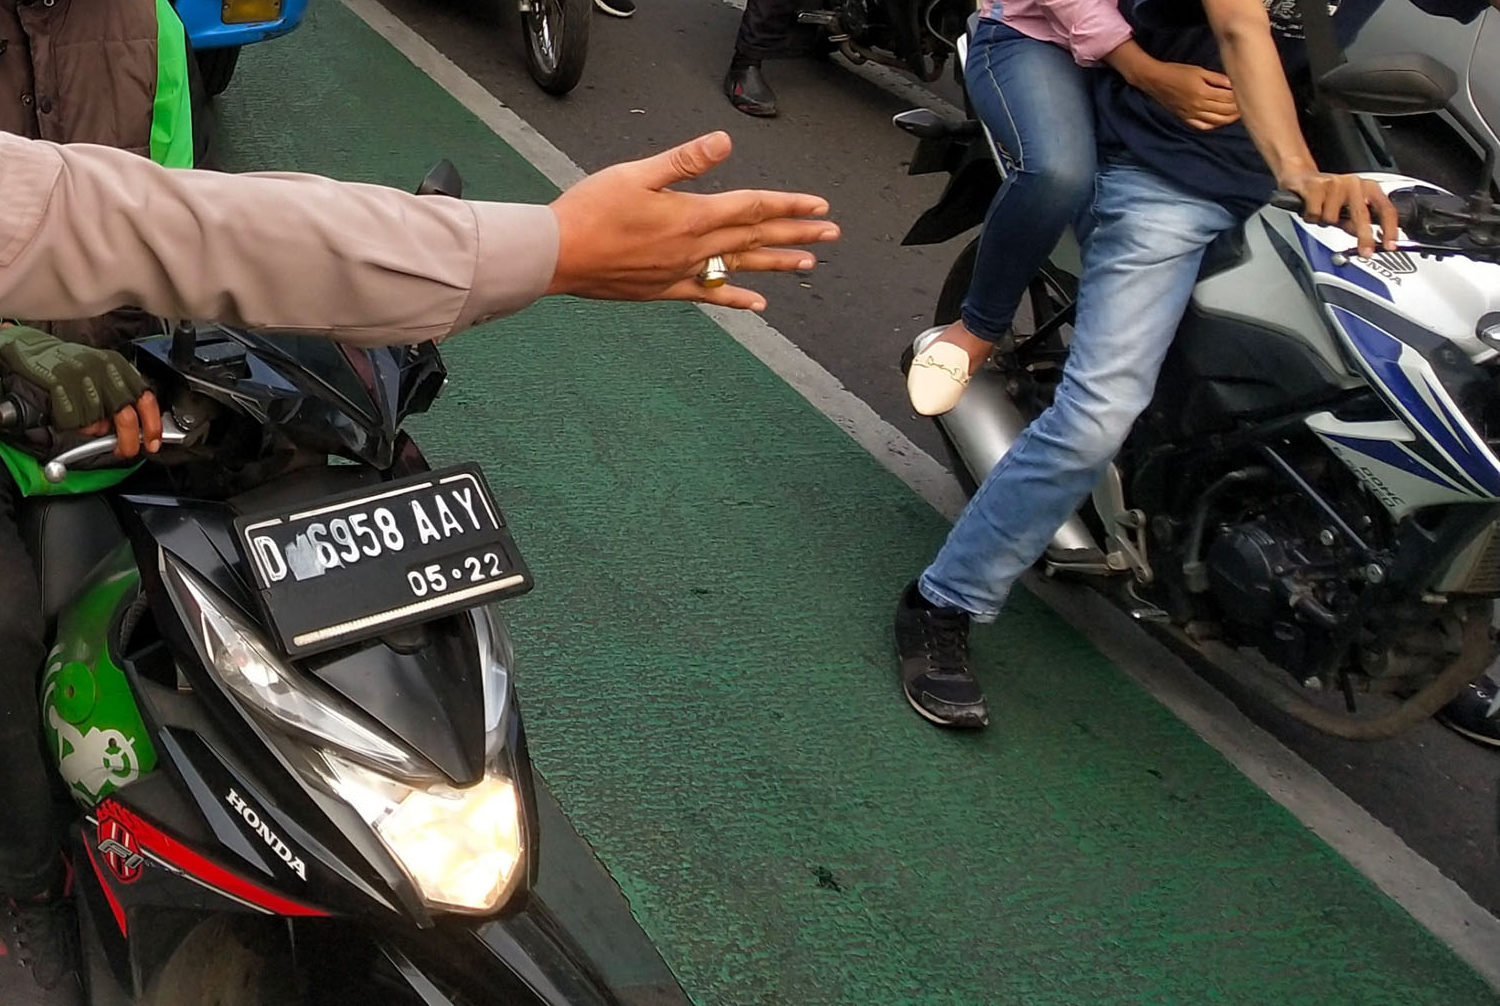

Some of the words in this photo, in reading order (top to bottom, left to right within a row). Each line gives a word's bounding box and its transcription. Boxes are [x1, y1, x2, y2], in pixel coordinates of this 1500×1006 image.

[253, 535, 288, 582] D
[306, 507, 405, 570] 6958
[410, 487, 482, 545] AAY
[225, 787, 308, 882] HONDA
